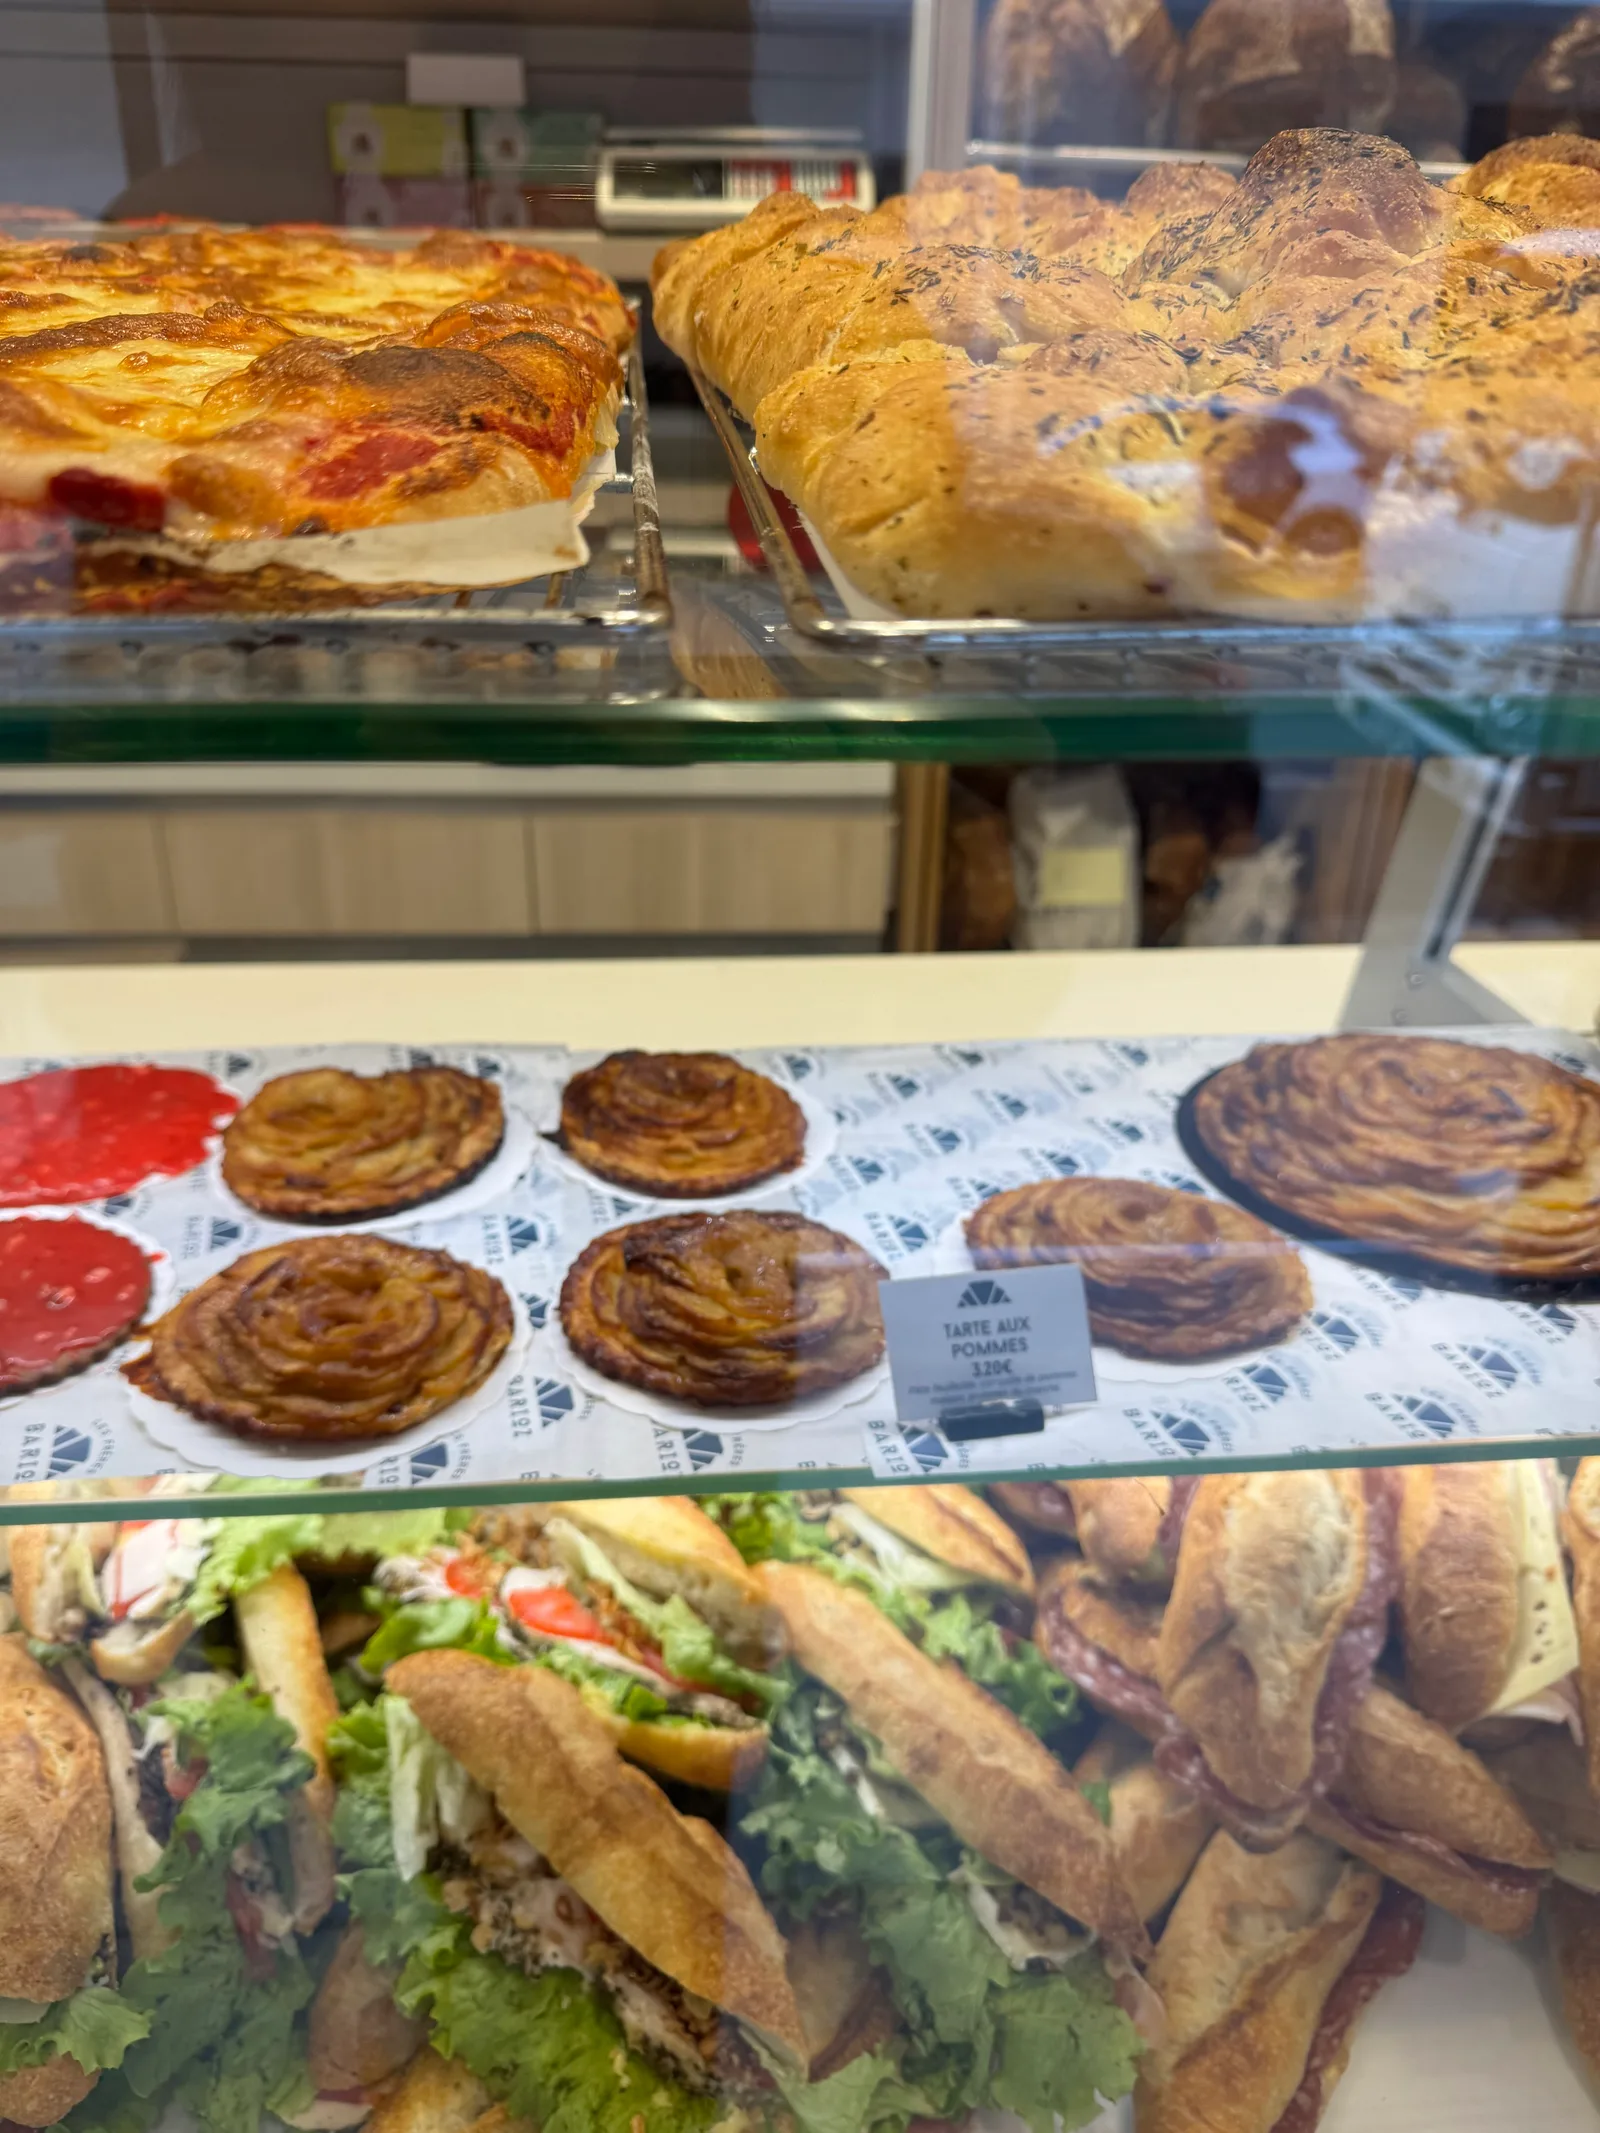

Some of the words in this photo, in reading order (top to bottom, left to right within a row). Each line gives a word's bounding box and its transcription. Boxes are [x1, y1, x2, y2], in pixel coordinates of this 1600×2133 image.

[943, 1319, 992, 1341] TARTE
[997, 1315, 1032, 1334] AUX
[951, 1336, 1029, 1360] POMMES
